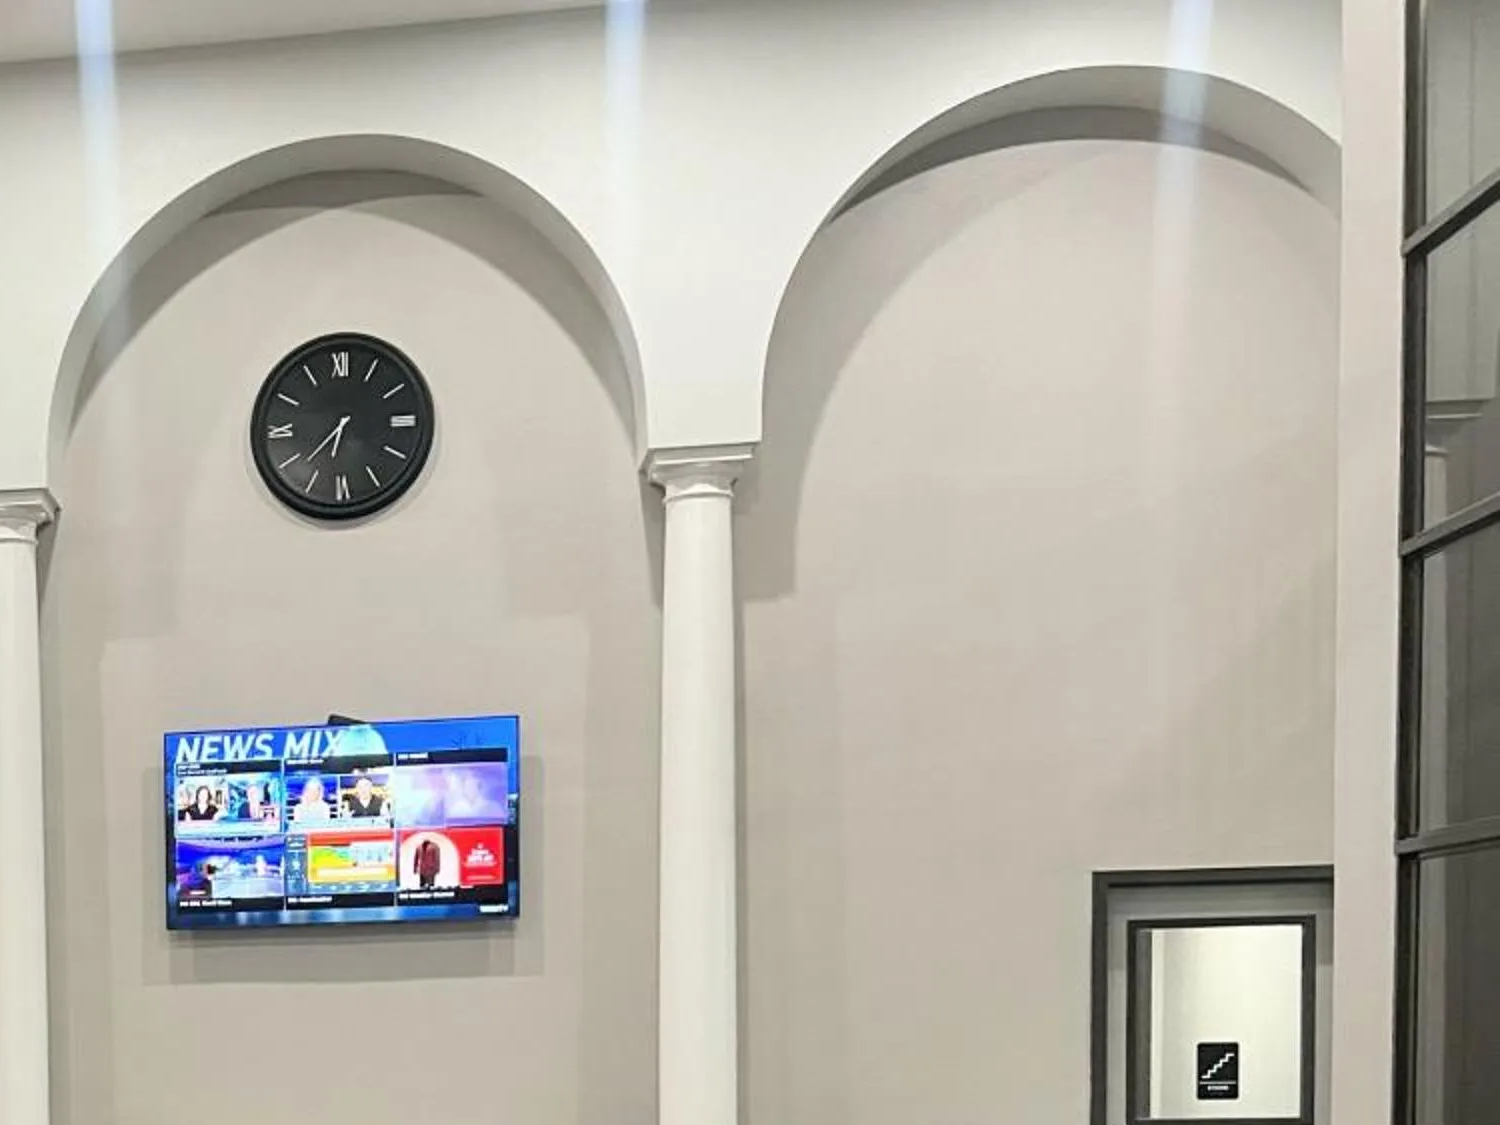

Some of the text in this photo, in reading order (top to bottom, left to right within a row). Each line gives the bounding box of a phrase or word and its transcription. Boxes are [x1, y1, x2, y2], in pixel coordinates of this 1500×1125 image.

[332, 352, 349, 377] XII
[176, 729, 343, 763] NEWS MIX
